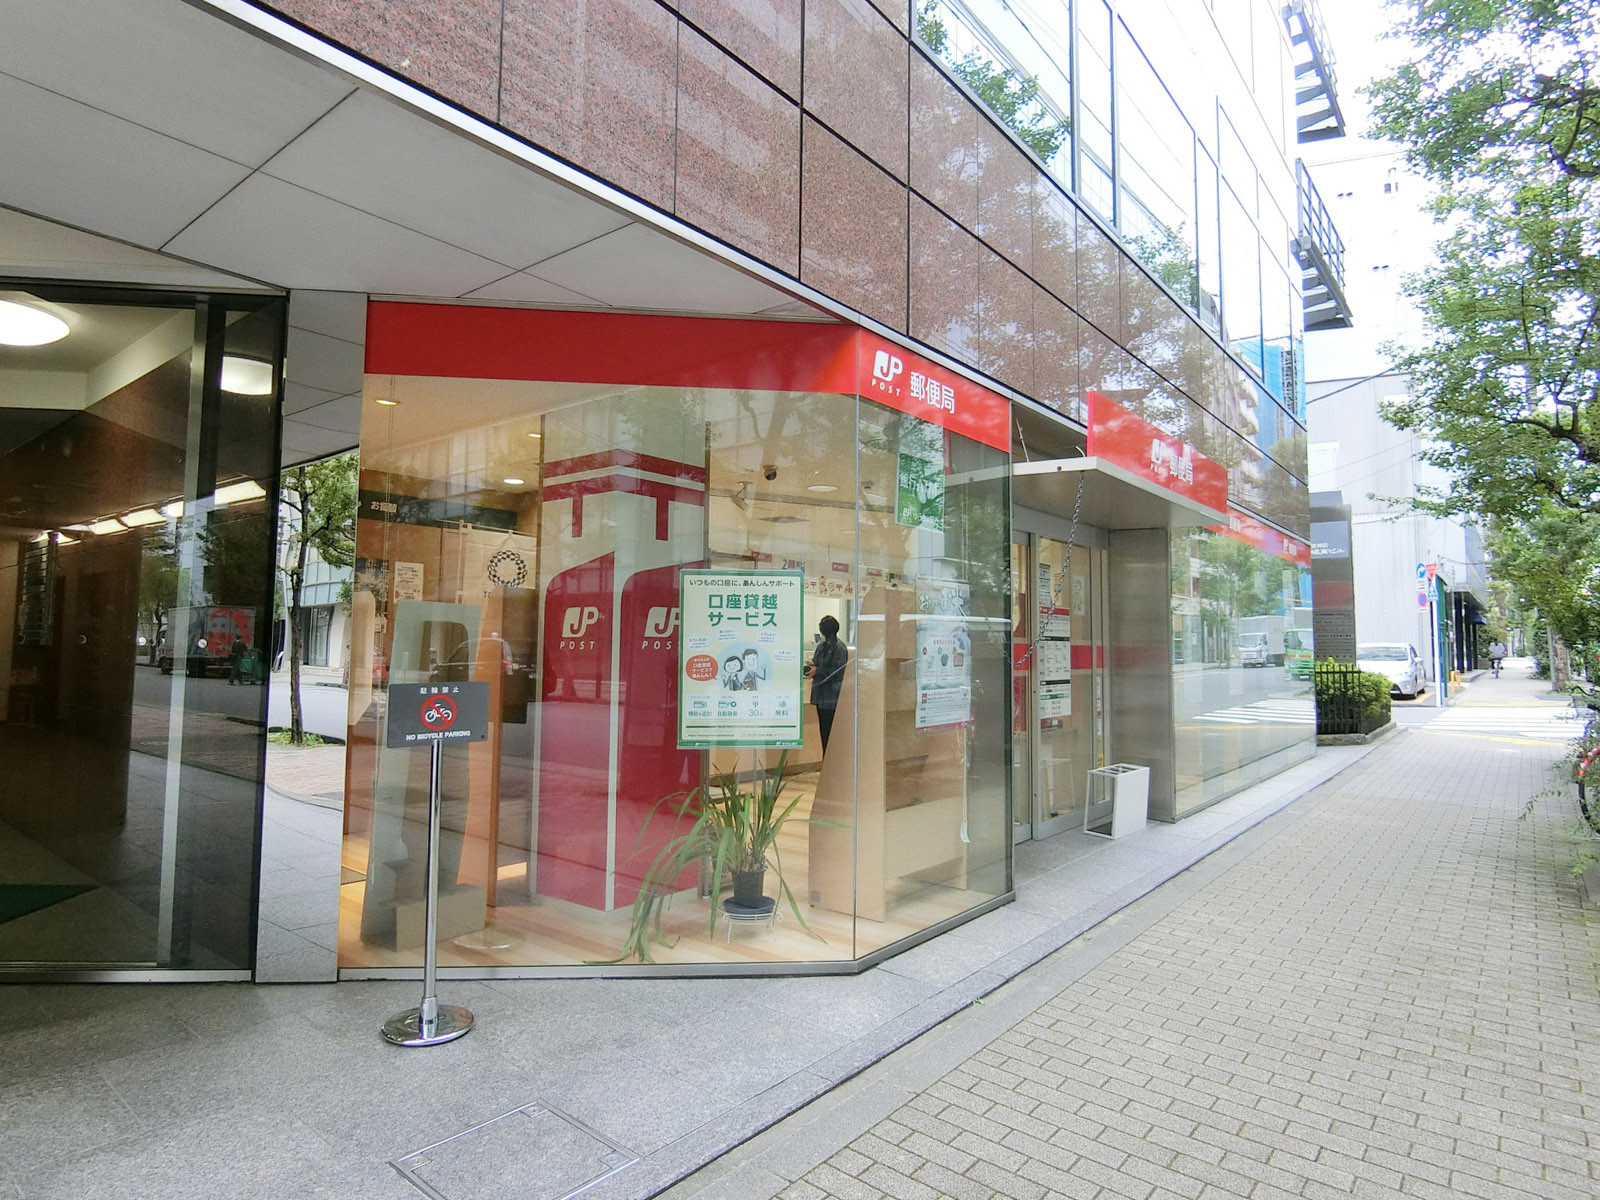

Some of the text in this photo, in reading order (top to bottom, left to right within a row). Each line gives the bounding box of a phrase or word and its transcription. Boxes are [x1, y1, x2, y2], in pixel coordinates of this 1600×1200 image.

[873, 350, 903, 382] JP
[872, 379, 900, 396] POST
[910, 371, 955, 414] 郵便局
[689, 579, 795, 587] いつもの口座に、あんしんサポート
[708, 594, 778, 609] 口座貸越
[562, 606, 599, 637] JP
[708, 612, 778, 627] サービス
[560, 641, 595, 649] POST
[642, 641, 672, 649] POS
[420, 686, 460, 694] 駐輪禁止
[417, 732, 443, 740] BICYCLE
[445, 730, 471, 738] PARKING
